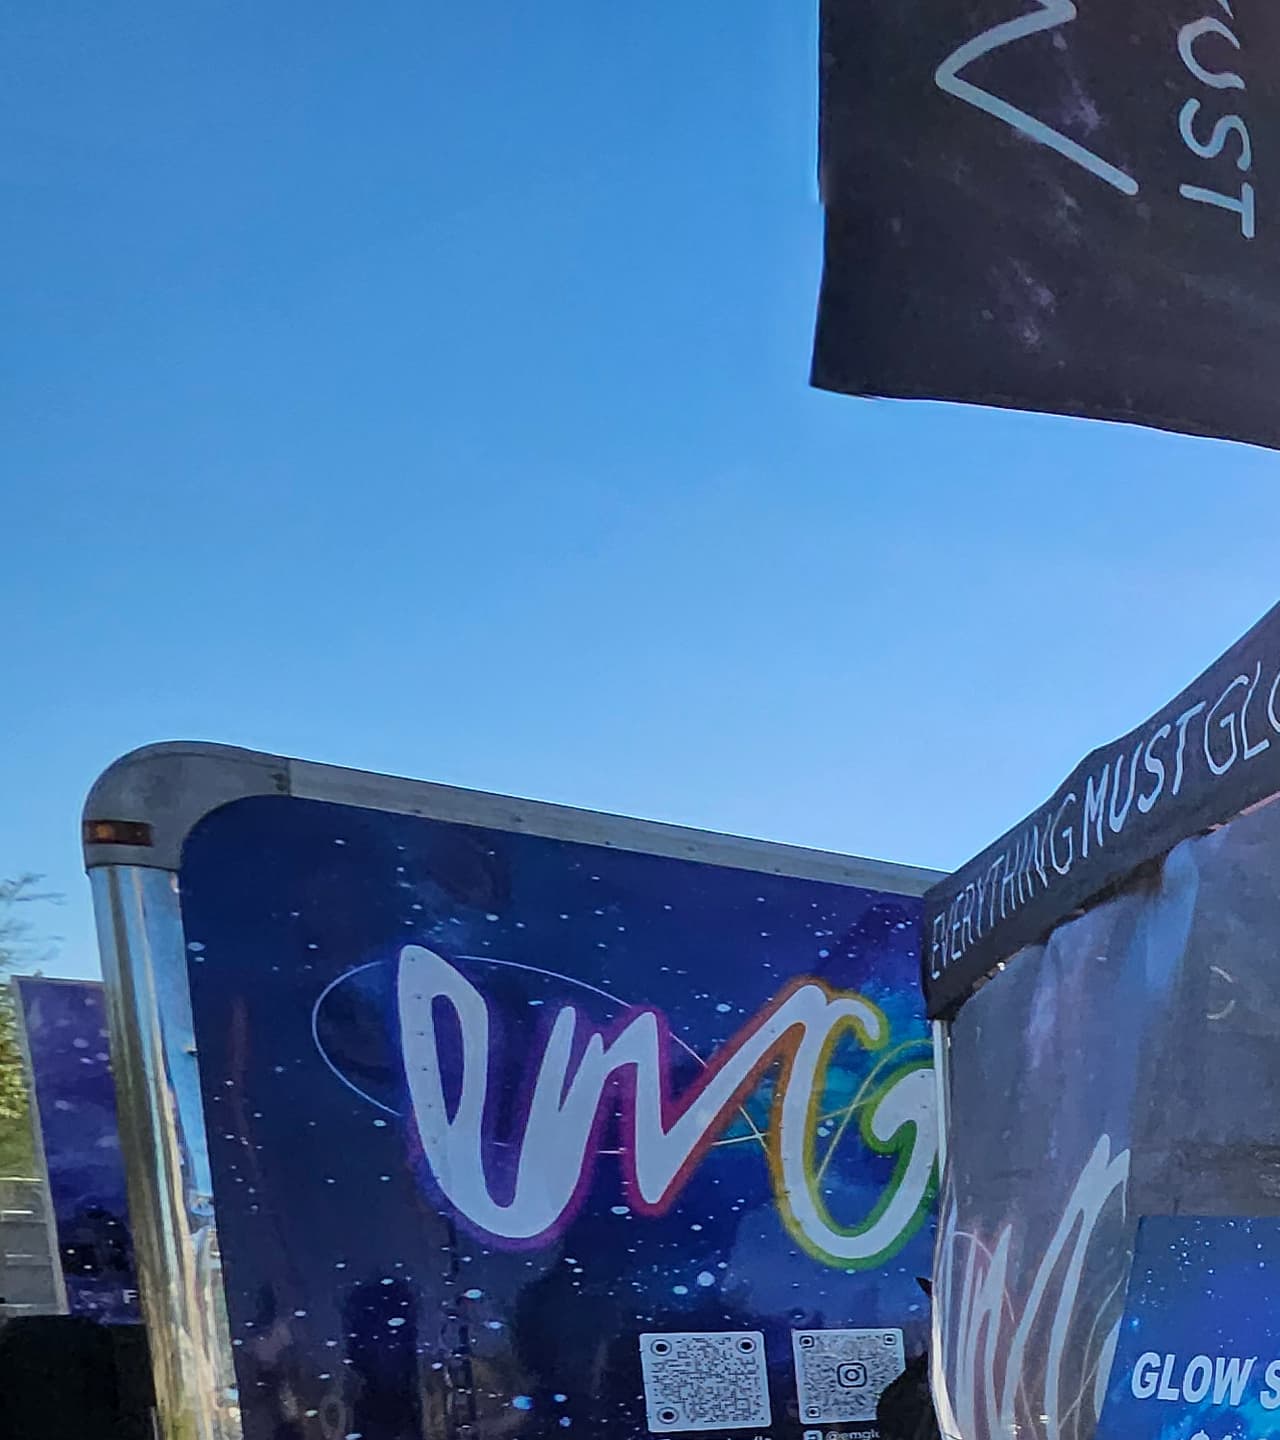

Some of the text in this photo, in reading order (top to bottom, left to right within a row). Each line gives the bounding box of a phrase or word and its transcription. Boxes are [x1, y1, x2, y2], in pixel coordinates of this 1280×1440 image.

[1177, 0, 1255, 240] UST
[931, 793, 1077, 980] EVERYTHING
[1081, 701, 1206, 859] MUST
[1131, 1350, 1258, 1407] GLOW
